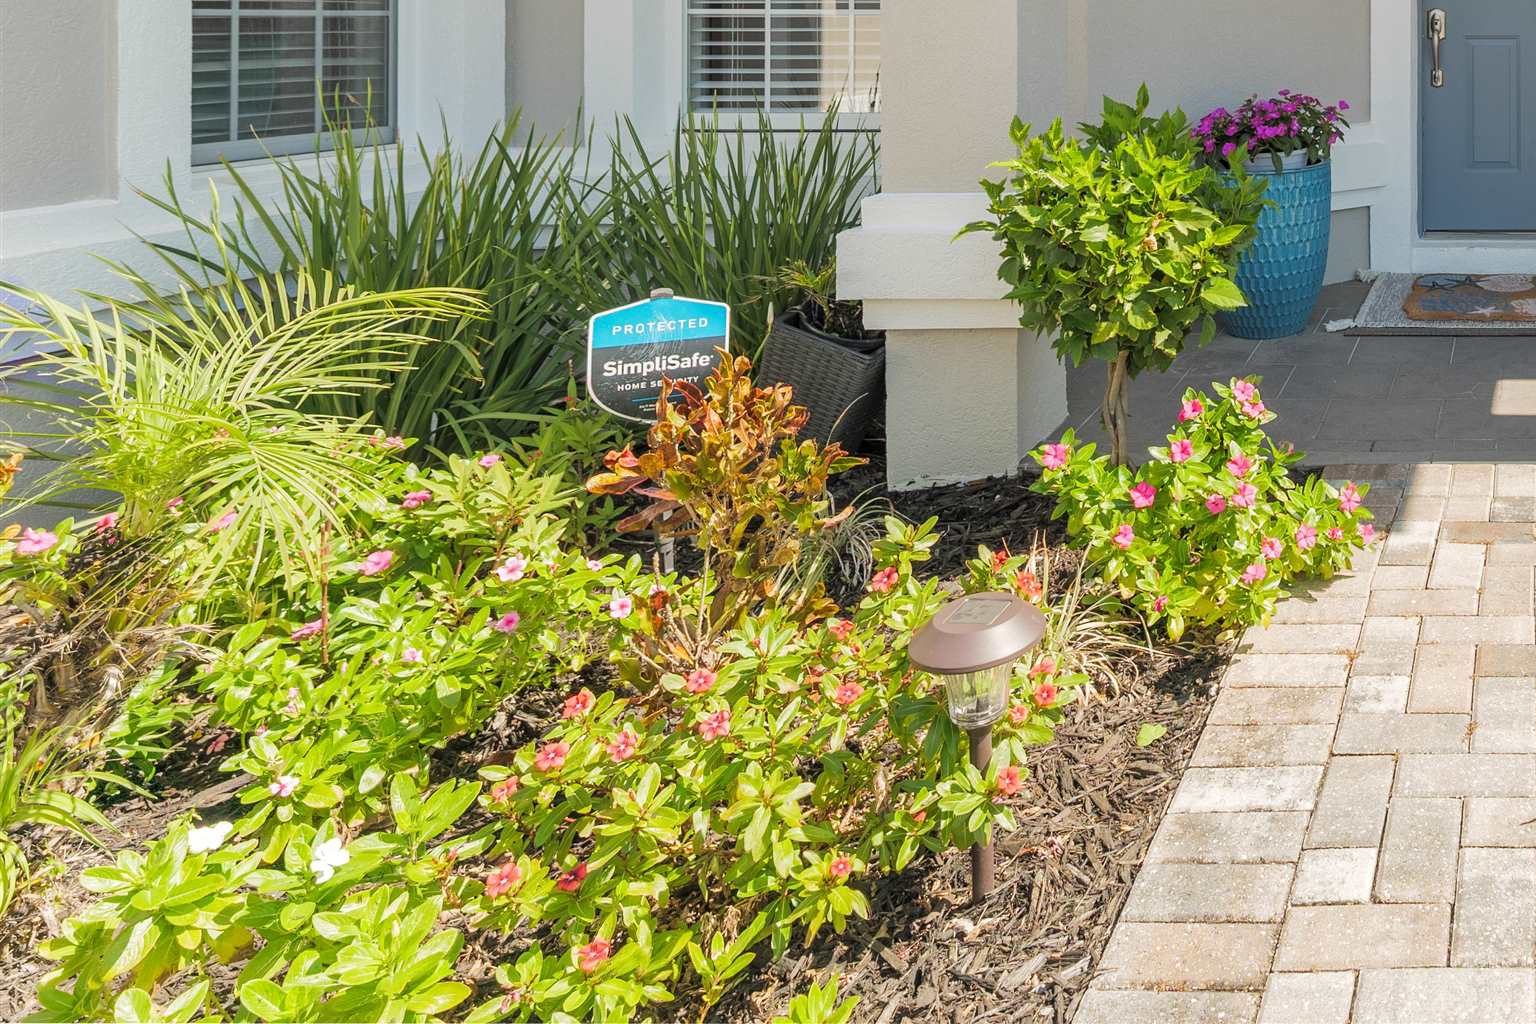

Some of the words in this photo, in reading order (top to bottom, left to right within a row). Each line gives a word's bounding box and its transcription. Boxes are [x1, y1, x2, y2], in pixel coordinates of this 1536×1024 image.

[612, 318, 708, 335] PROTECTED
[602, 352, 711, 377] SimpliSafe
[617, 382, 647, 391] HOME
[650, 376, 699, 388] SEURITY
